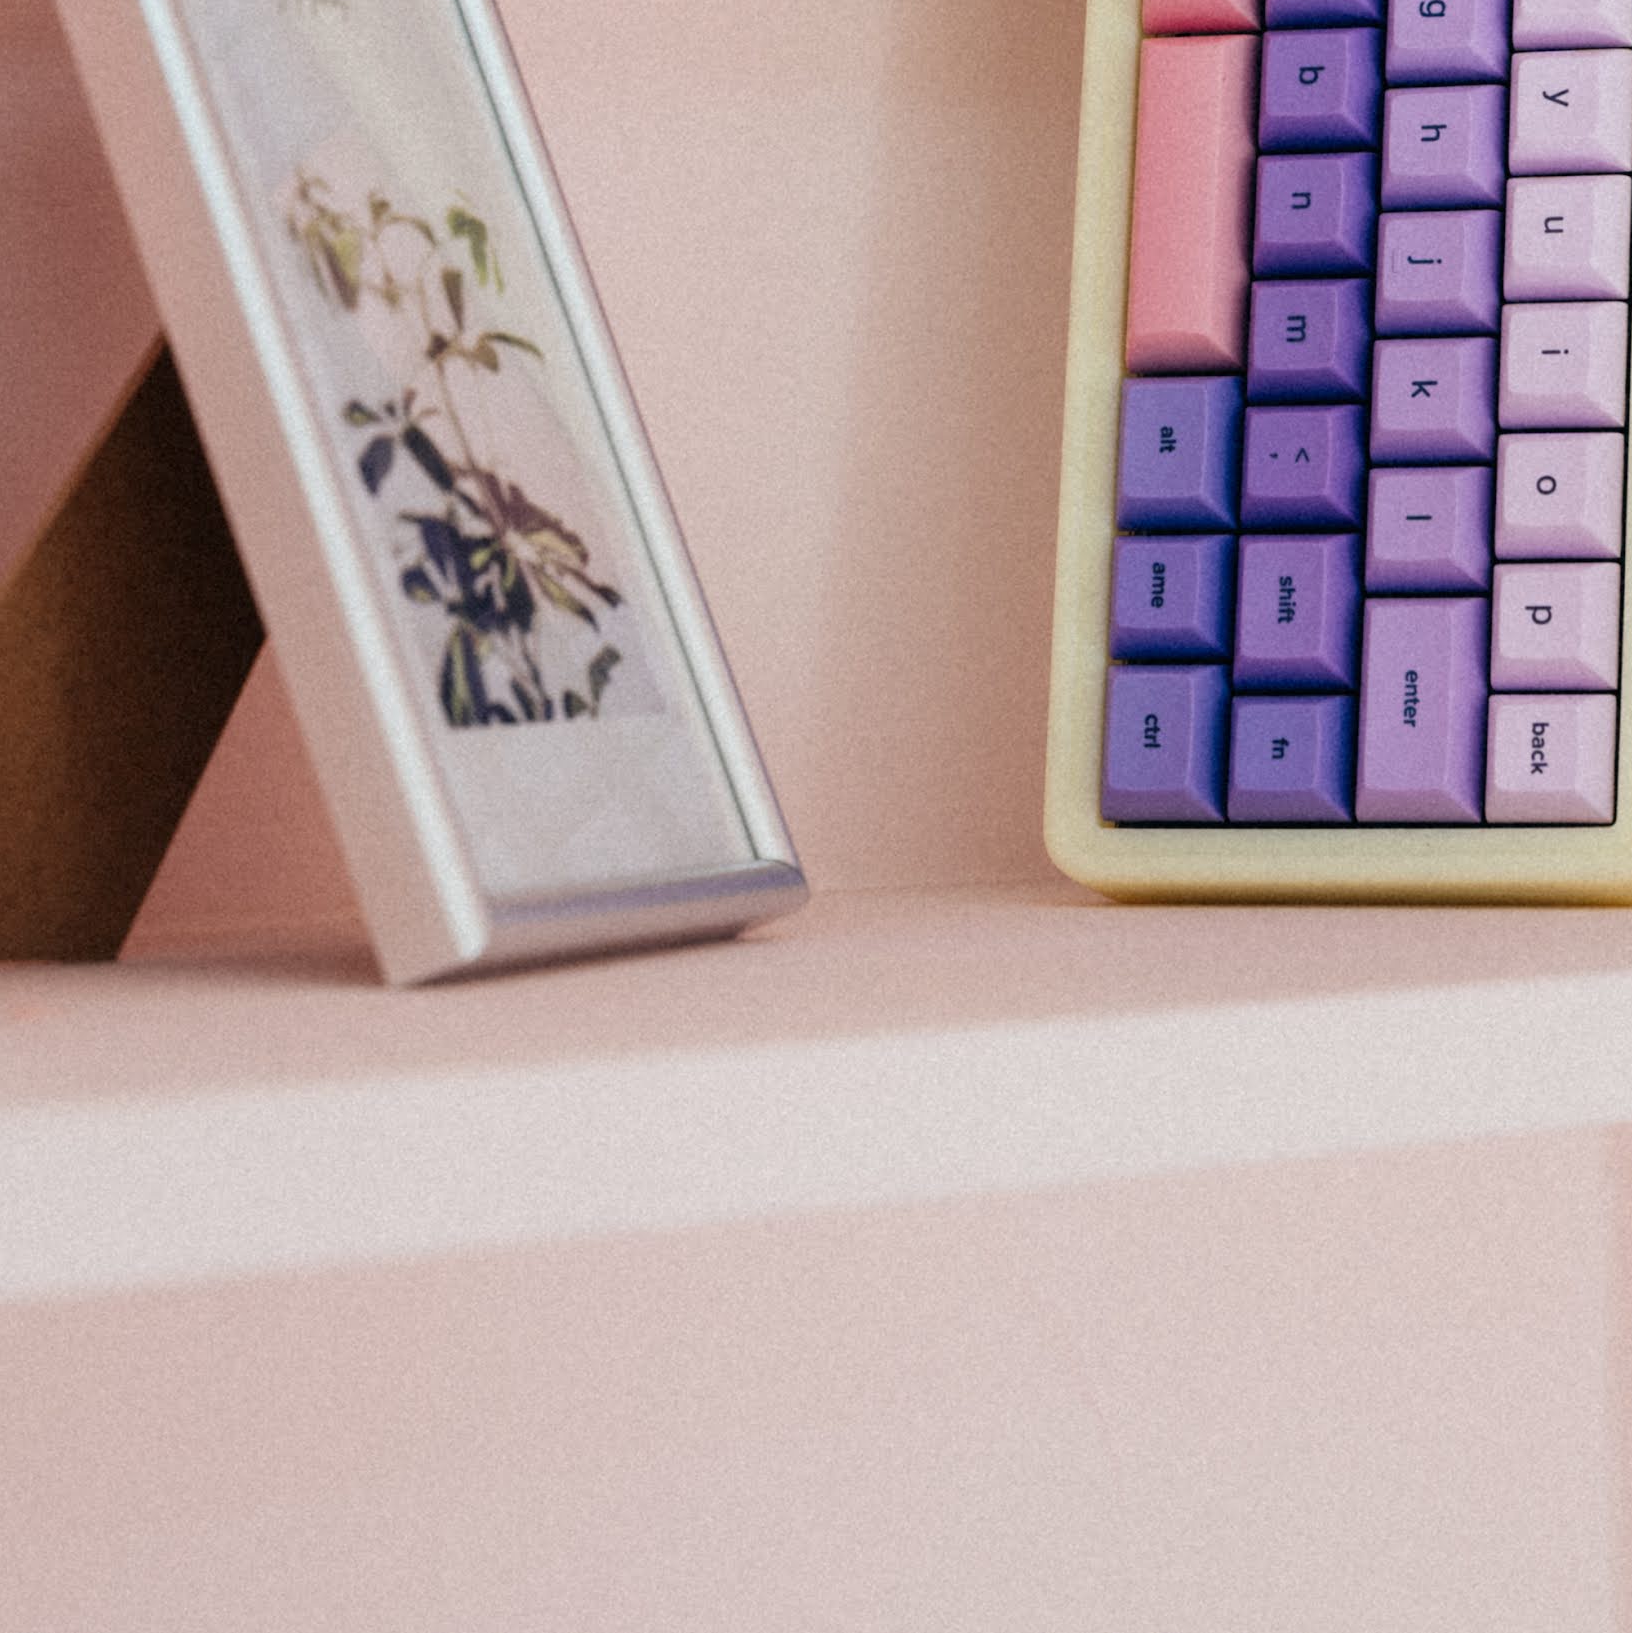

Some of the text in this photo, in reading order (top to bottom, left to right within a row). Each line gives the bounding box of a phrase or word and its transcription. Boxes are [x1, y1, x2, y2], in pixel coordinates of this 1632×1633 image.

[1296, 64, 1327, 87] b
[1540, 87, 1571, 109] y
[1419, 122, 1449, 144] h
[1290, 190, 1313, 212] n
[1542, 214, 1566, 236] u
[1405, 254, 1444, 267] j
[1284, 313, 1309, 345] m
[1409, 378, 1439, 399] k
[1157, 424, 1179, 455] alt
[1534, 473, 1559, 497] o
[1149, 560, 1168, 610] ame
[1276, 574, 1298, 625] shift
[1523, 603, 1554, 627] p
[1401, 668, 1421, 729] enter
[1142, 712, 1163, 751] ctrl
[1270, 736, 1291, 761] fn
[1529, 720, 1551, 776] back
